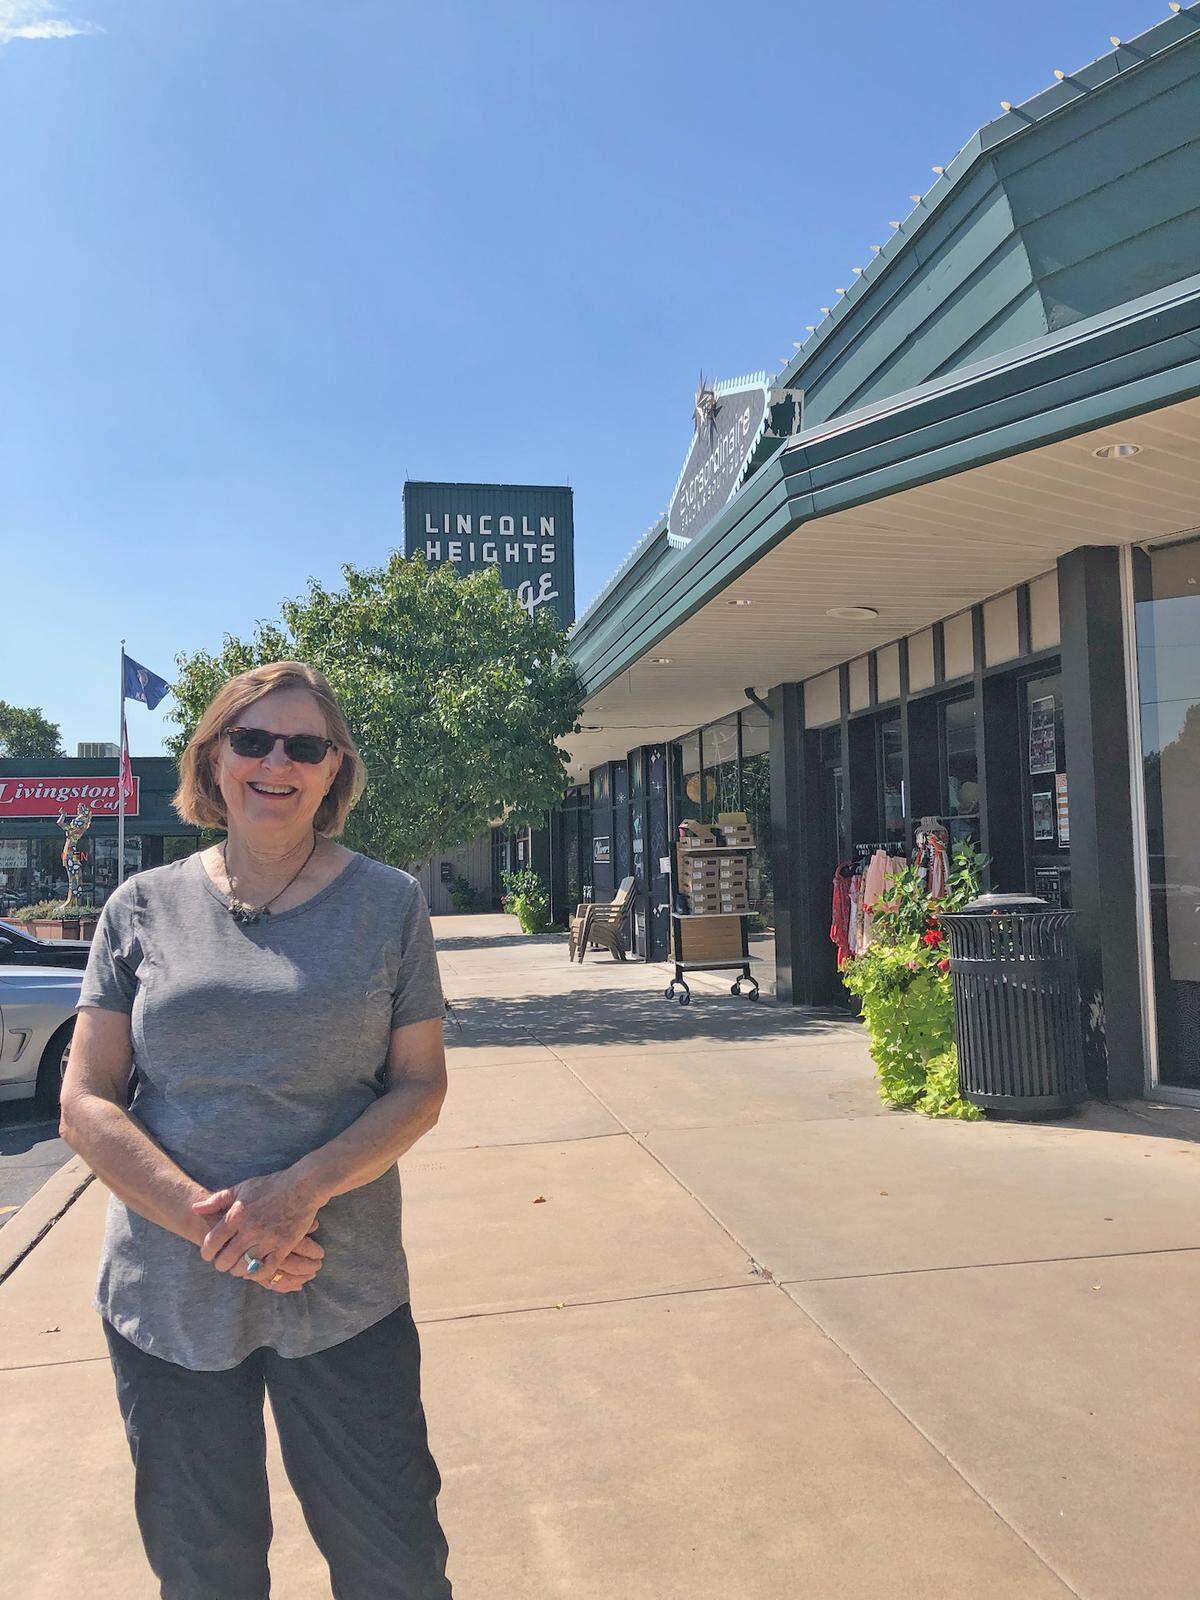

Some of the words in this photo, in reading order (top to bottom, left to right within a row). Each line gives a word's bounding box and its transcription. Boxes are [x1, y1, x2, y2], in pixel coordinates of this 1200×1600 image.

[425, 513, 555, 537] LINCOLN
[426, 540, 556, 564] HEIGHTS
[0, 783, 130, 803] Livingston
[90, 798, 128, 810] Caf
